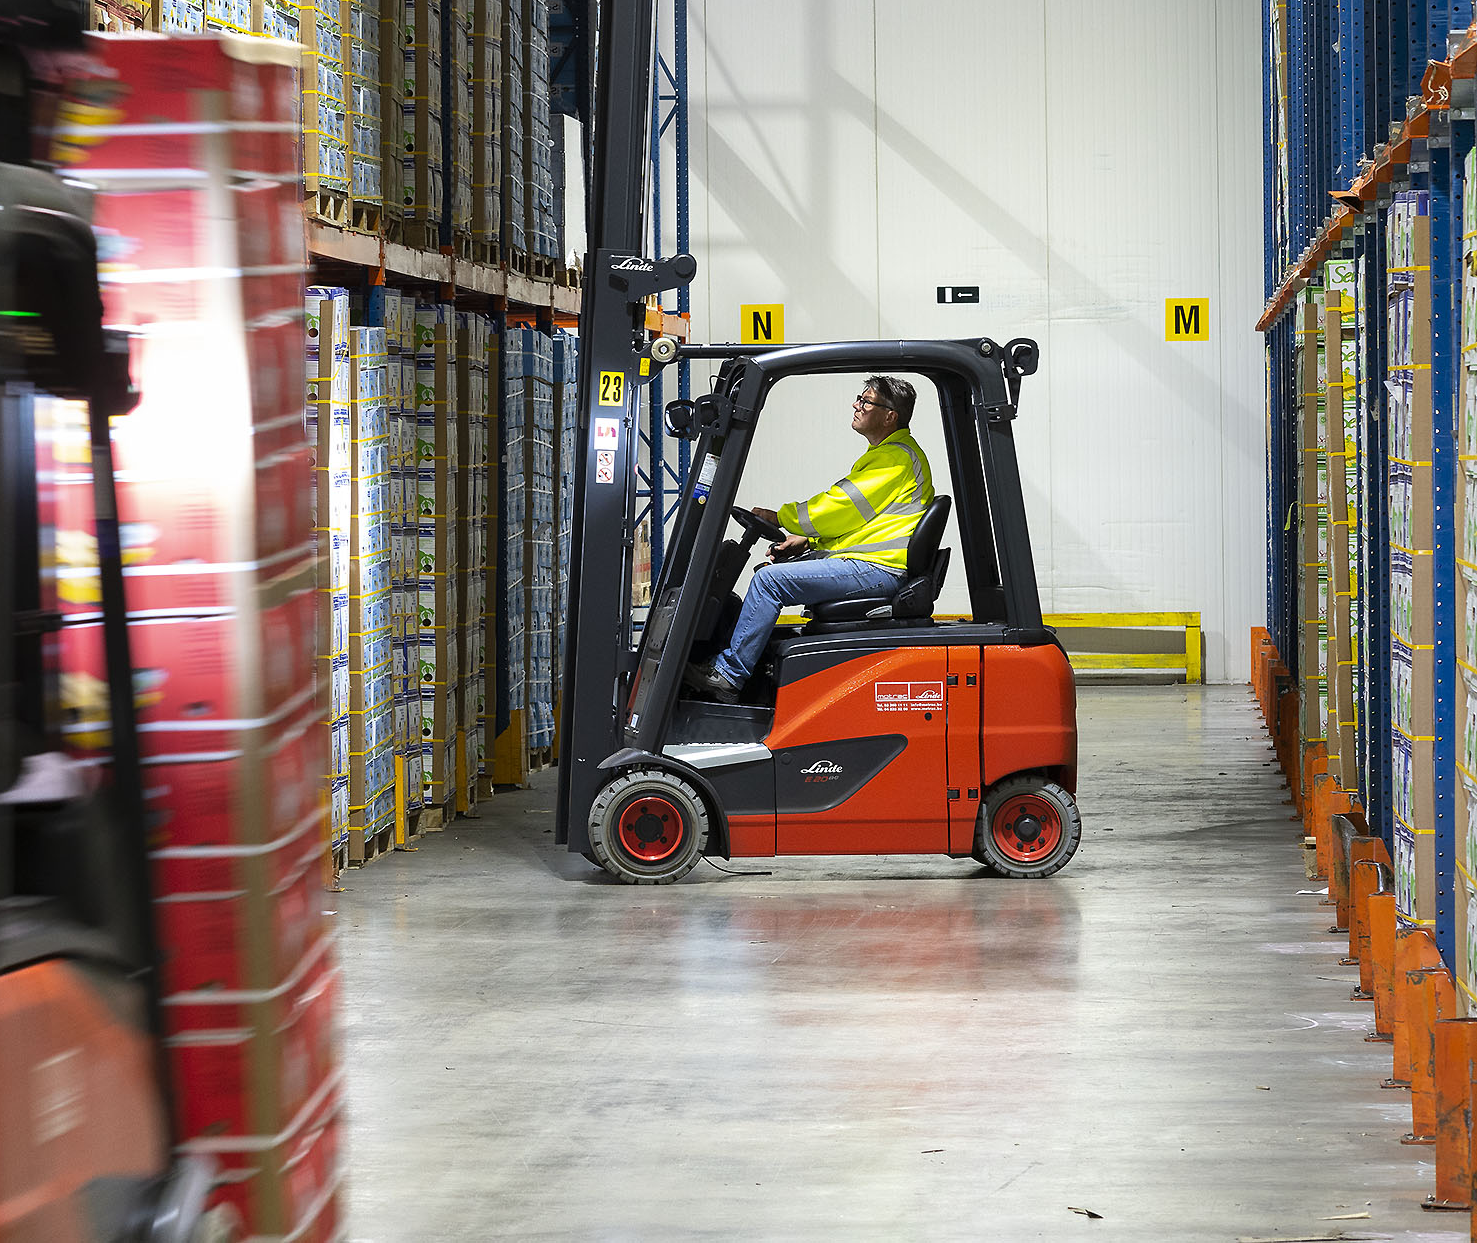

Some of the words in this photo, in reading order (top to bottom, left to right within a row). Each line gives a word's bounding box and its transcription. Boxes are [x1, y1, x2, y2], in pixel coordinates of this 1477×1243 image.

[611, 258, 654, 272] Linde
[753, 311, 772, 340] N
[1174, 306, 1200, 335] M
[601, 374, 622, 403] 23
[915, 689, 940, 699] Linde
[800, 759, 843, 773] Linde
